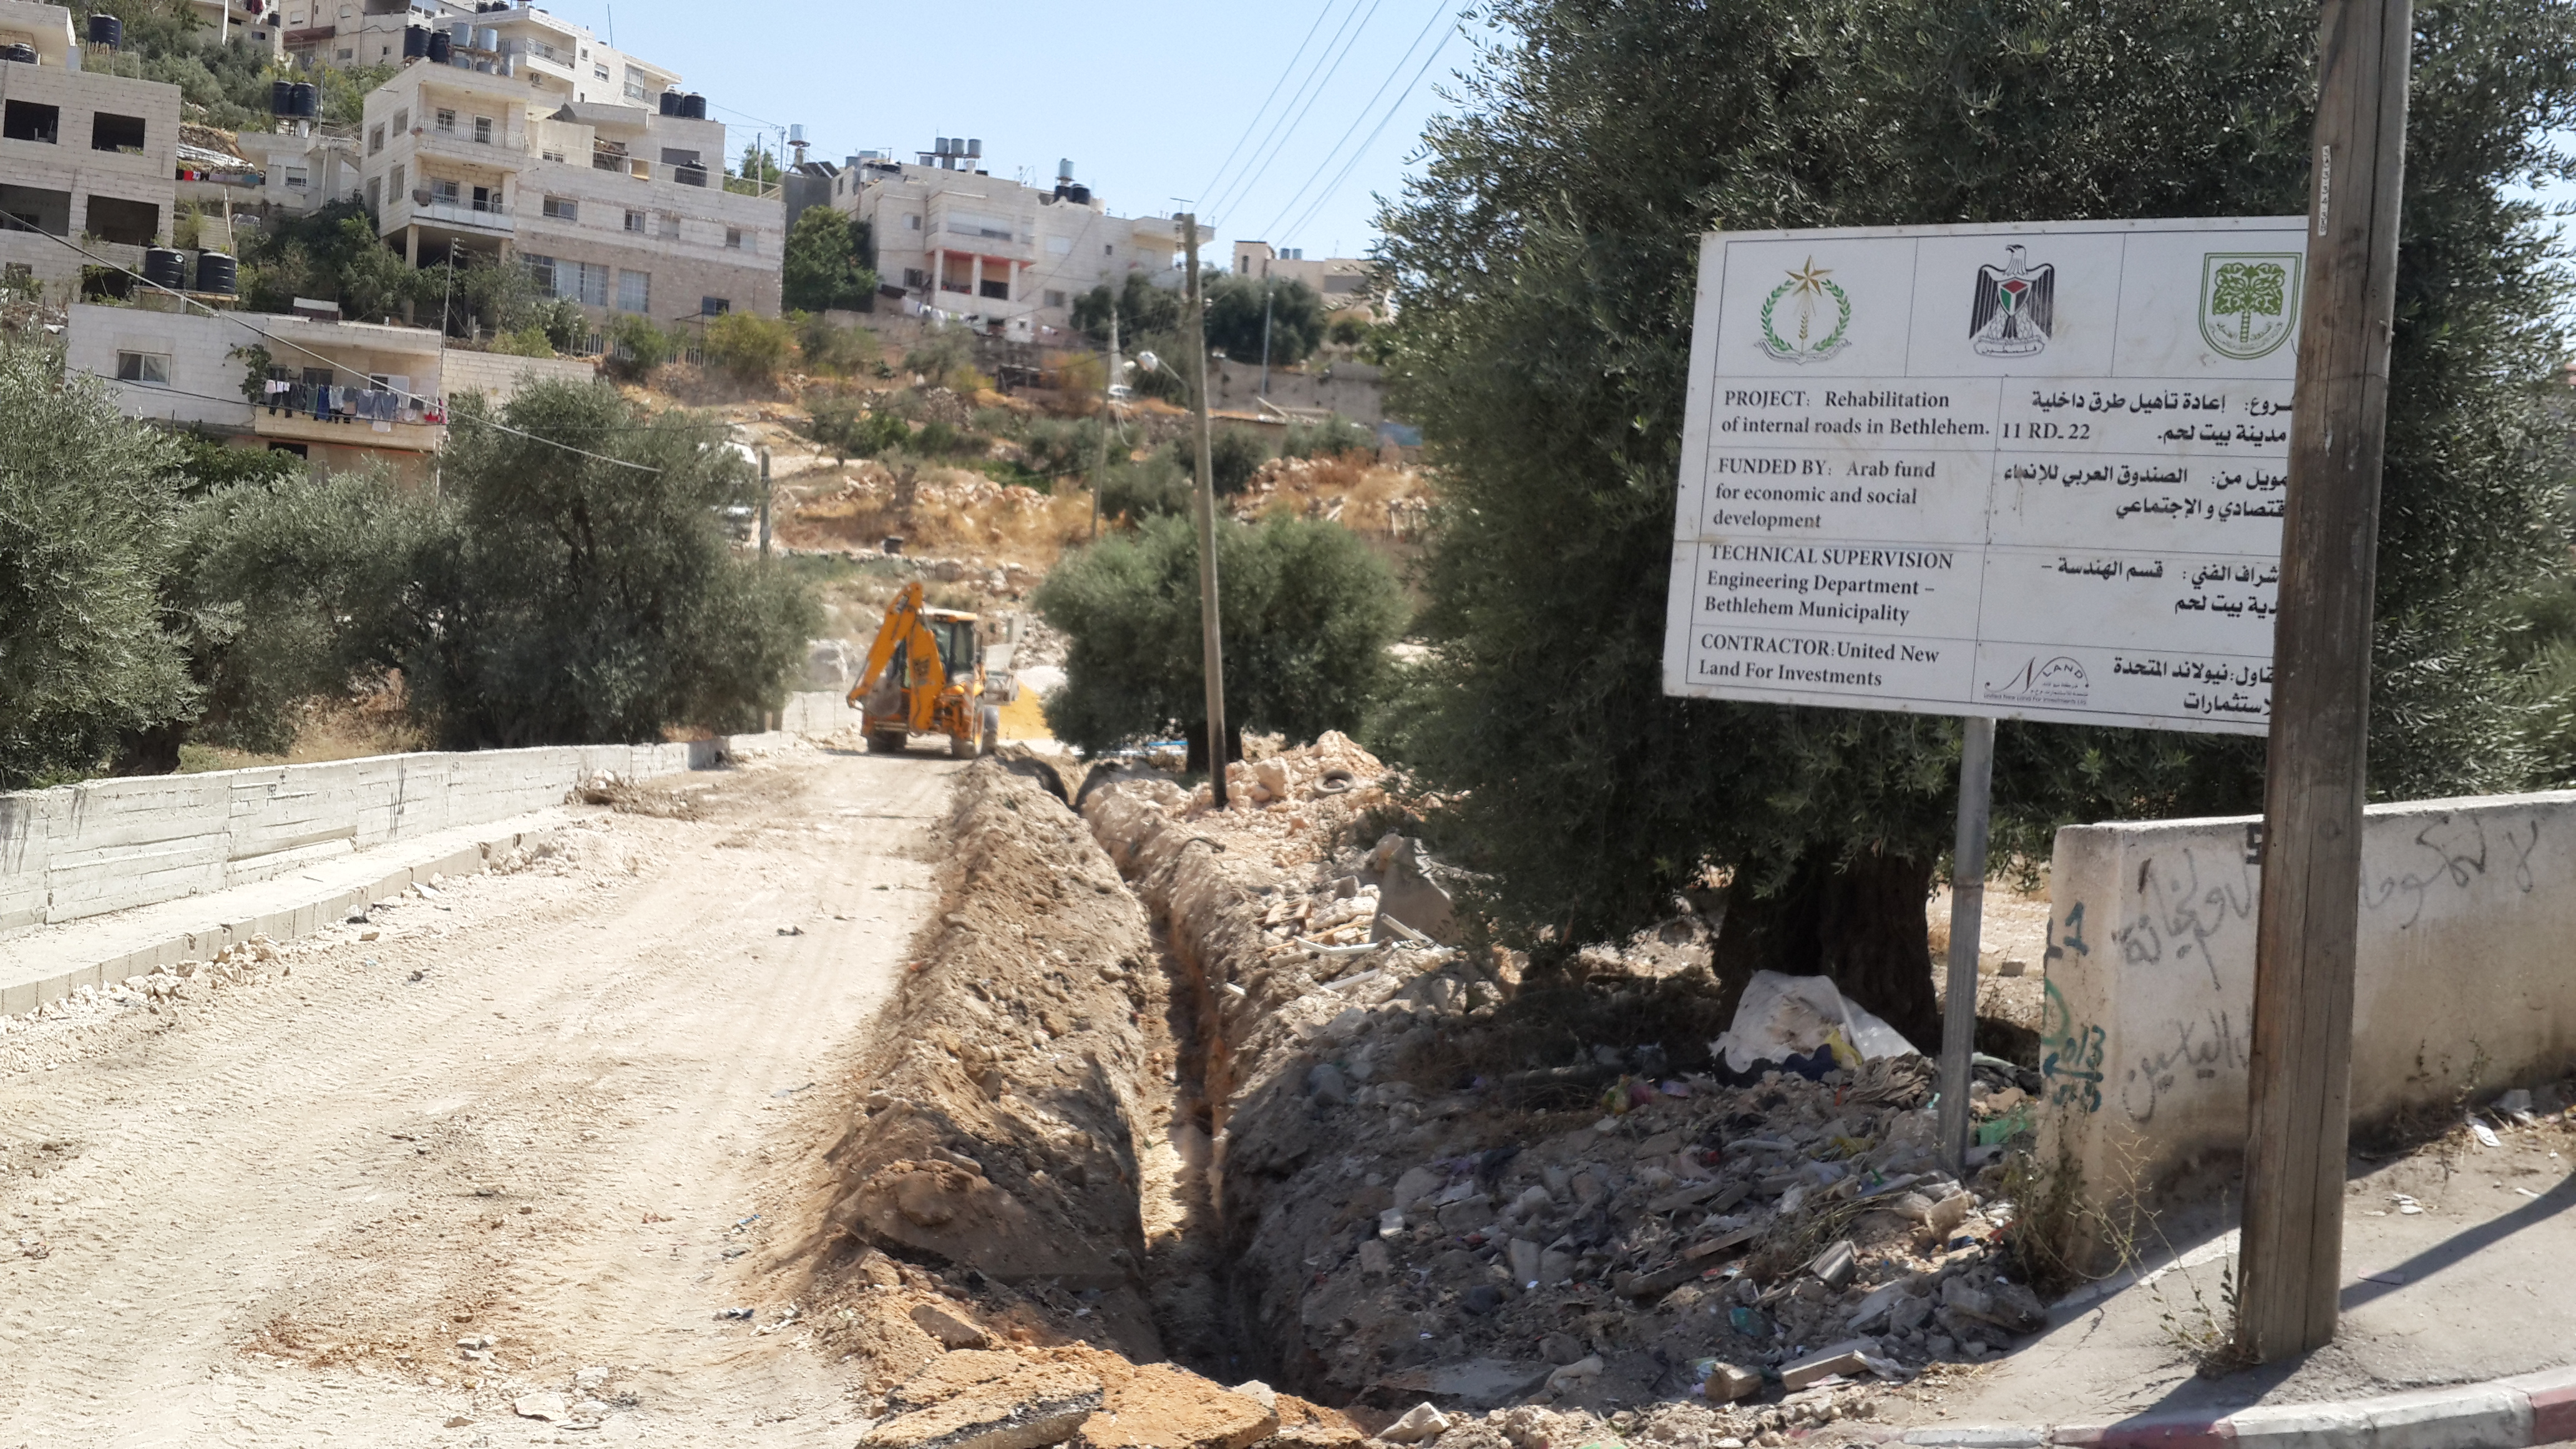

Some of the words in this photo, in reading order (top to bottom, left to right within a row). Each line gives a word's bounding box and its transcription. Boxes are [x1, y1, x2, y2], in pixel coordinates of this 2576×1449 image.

[1725, 390, 1810, 408] PROJECT:
[1825, 390, 1949, 408] Rehabilitation
[2032, 391, 2086, 413] داخلية
[2088, 391, 2126, 414] طرق
[2129, 389, 2178, 414] تأهيل
[2182, 392, 2226, 414] إعادة
[2244, 397, 2295, 417] روع:
[1721, 416, 1740, 432] of
[1743, 416, 1810, 433] internal
[1815, 417, 1861, 434] roads
[1867, 418, 1883, 434] in
[1890, 417, 1989, 435] Bethlehem.
[2003, 422, 2021, 439] 11
[2157, 424, 2196, 445] لحم.
[2199, 424, 2232, 447] بيت
[2235, 424, 2286, 447] مدينة
[1719, 457, 1797, 475] FUNDED
[1802, 459, 1832, 476] BY:
[1847, 460, 1890, 477] Arab
[1895, 460, 1936, 478] fund
[2062, 465, 2114, 488] العربي
[2117, 464, 2188, 487] الصندوق
[2211, 470, 2242, 490] من:
[2246, 469, 2287, 492] مويل
[1715, 482, 1740, 500] for
[1744, 485, 1825, 502] economic
[1830, 486, 1862, 503] and
[1866, 487, 1917, 504] social
[2115, 496, 2202, 520] الإجتماعي
[2203, 504, 2215, 520] و
[2218, 500, 2285, 523] قتصادي
[1712, 509, 1822, 532] development
[1710, 544, 1818, 564] TECHNICAL
[1822, 548, 1954, 570] SUPERVISION
[2057, 556, 2123, 580] الهندسة
[2126, 560, 2164, 582] قسم
[2191, 564, 2232, 590] الفني
[2235, 565, 2277, 588] شراف
[1707, 570, 1809, 595] Engineering
[1814, 575, 1918, 597] Department
[1704, 595, 1793, 616] Bethlehem
[1798, 600, 1910, 627] Municipality
[2175, 594, 2208, 615] لحم
[2210, 594, 2243, 618] بيت
[1900, 645, 1939, 663] New
[1699, 659, 1740, 676] Land
[1745, 662, 1773, 679] For
[1778, 664, 1882, 686] Investments
[2042, 663, 2084, 679] LAND
[2113, 656, 2167, 678] المتحدة
